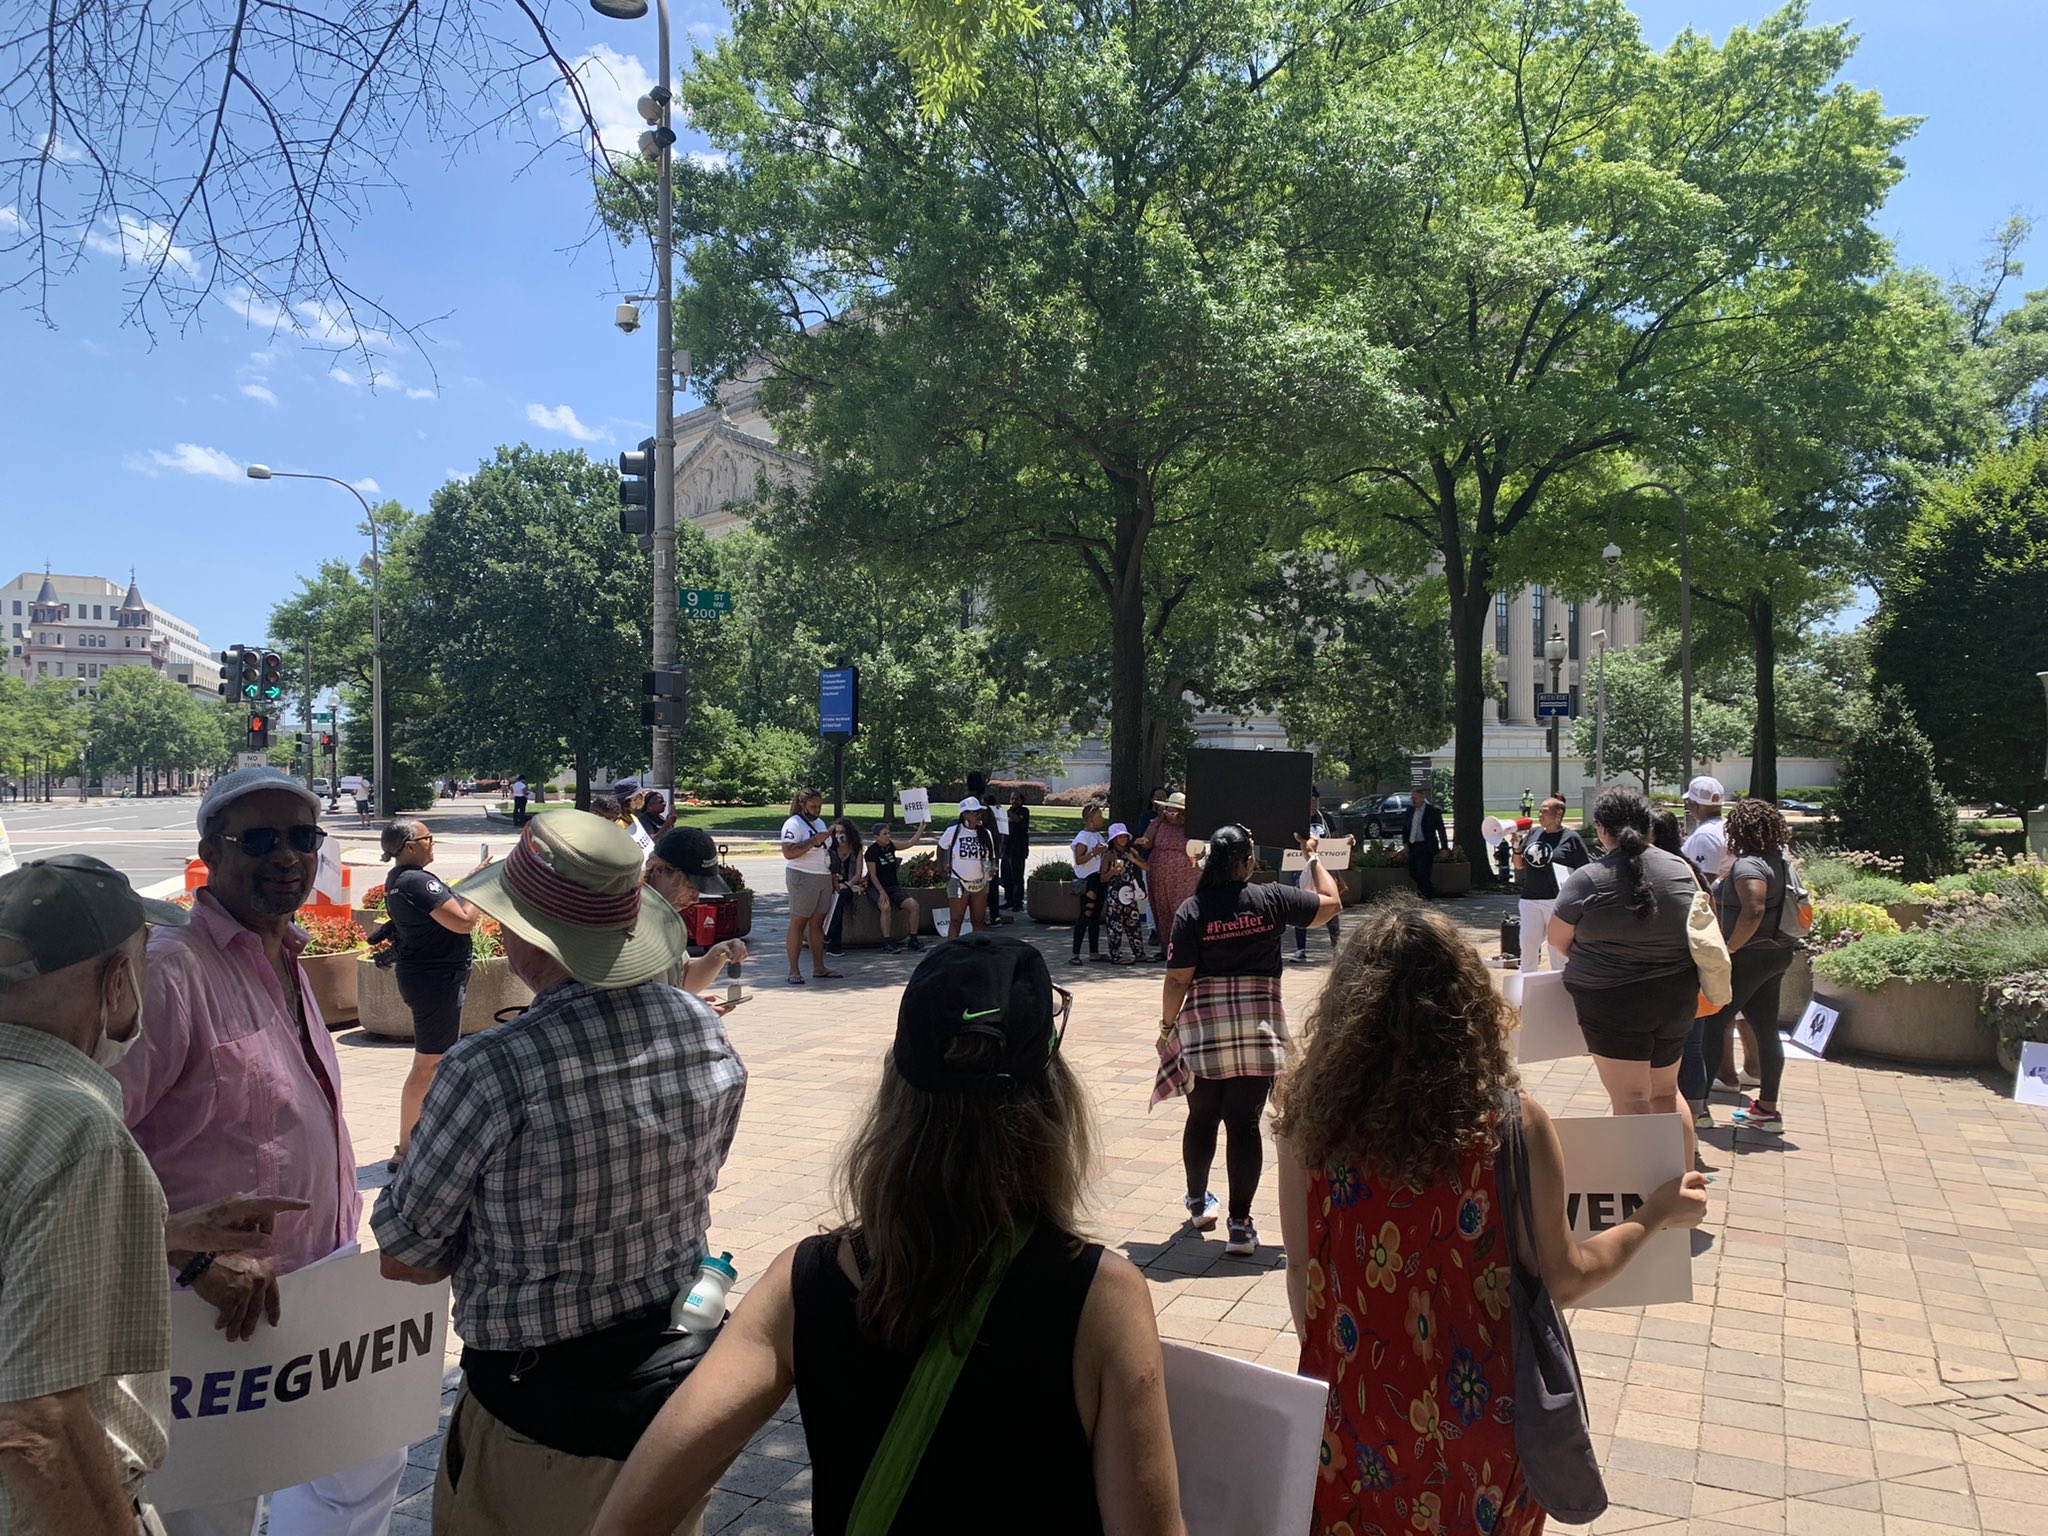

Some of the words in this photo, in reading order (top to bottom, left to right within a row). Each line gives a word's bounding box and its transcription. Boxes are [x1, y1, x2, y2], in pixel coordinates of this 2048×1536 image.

[687, 592, 699, 606] 9
[692, 608, 716, 618] 200
[1286, 850, 1348, 858] #CLECYNOW
[1206, 915, 1264, 934] #FreeHer
